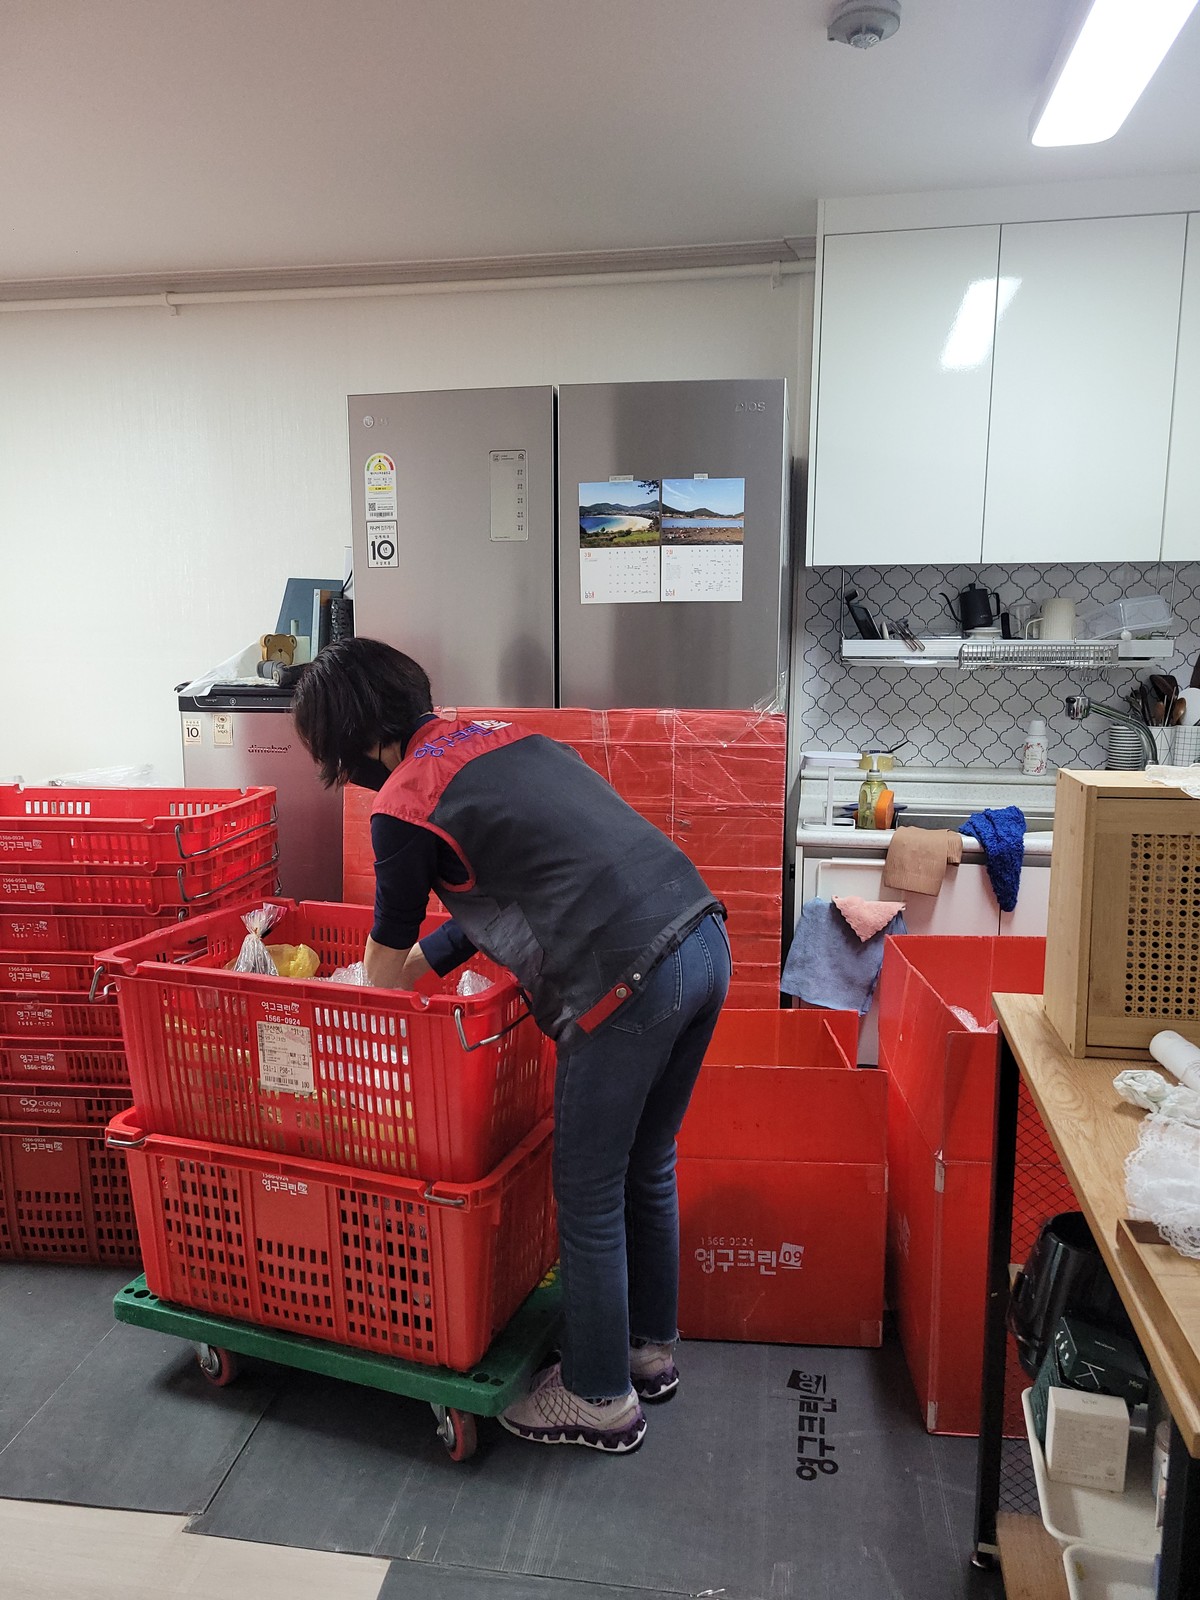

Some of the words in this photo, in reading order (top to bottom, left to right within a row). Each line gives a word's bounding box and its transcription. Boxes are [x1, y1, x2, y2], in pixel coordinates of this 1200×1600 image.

[371, 540, 395, 560] 10
[265, 1014, 301, 1026] 1566-0924
[261, 1179, 297, 1196] 영구크린
[694, 1248, 777, 1276] 영구크린
[796, 1394, 838, 1481] 영구크린
